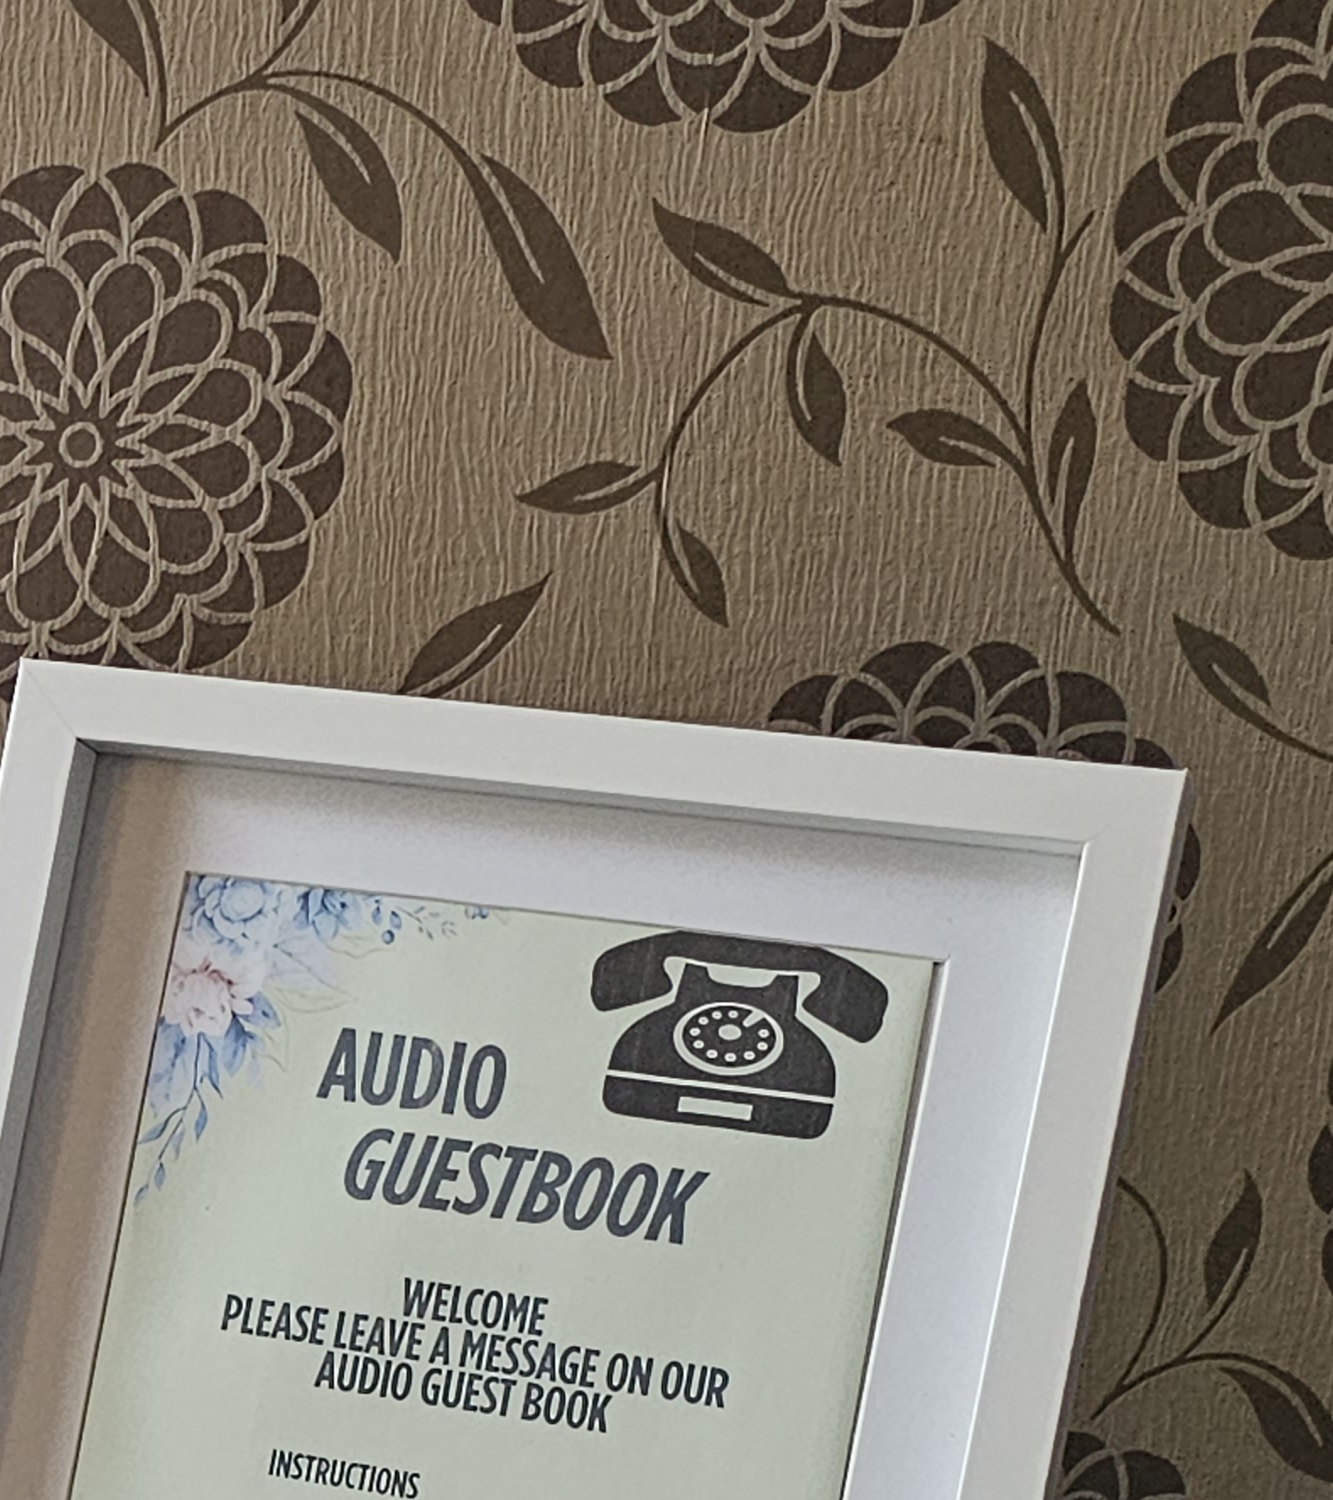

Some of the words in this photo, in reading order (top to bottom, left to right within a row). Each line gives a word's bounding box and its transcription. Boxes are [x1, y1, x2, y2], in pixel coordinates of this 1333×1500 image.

[316, 1027, 507, 1120] AUDIO
[344, 1128, 710, 1245] GUESTBOOK
[403, 1277, 548, 1337] WELCOME
[220, 1294, 329, 1346] PLEASE
[333, 1311, 425, 1362] LEAVE
[428, 1327, 451, 1365] A
[459, 1330, 600, 1389] MESSAGE
[606, 1353, 654, 1397] ON
[660, 1360, 729, 1409] OUR
[314, 1351, 413, 1401] AUDIO
[421, 1367, 517, 1417] GUEST
[521, 1382, 613, 1434] BOOK
[268, 1449, 420, 1499] INSTRUCTIONS
